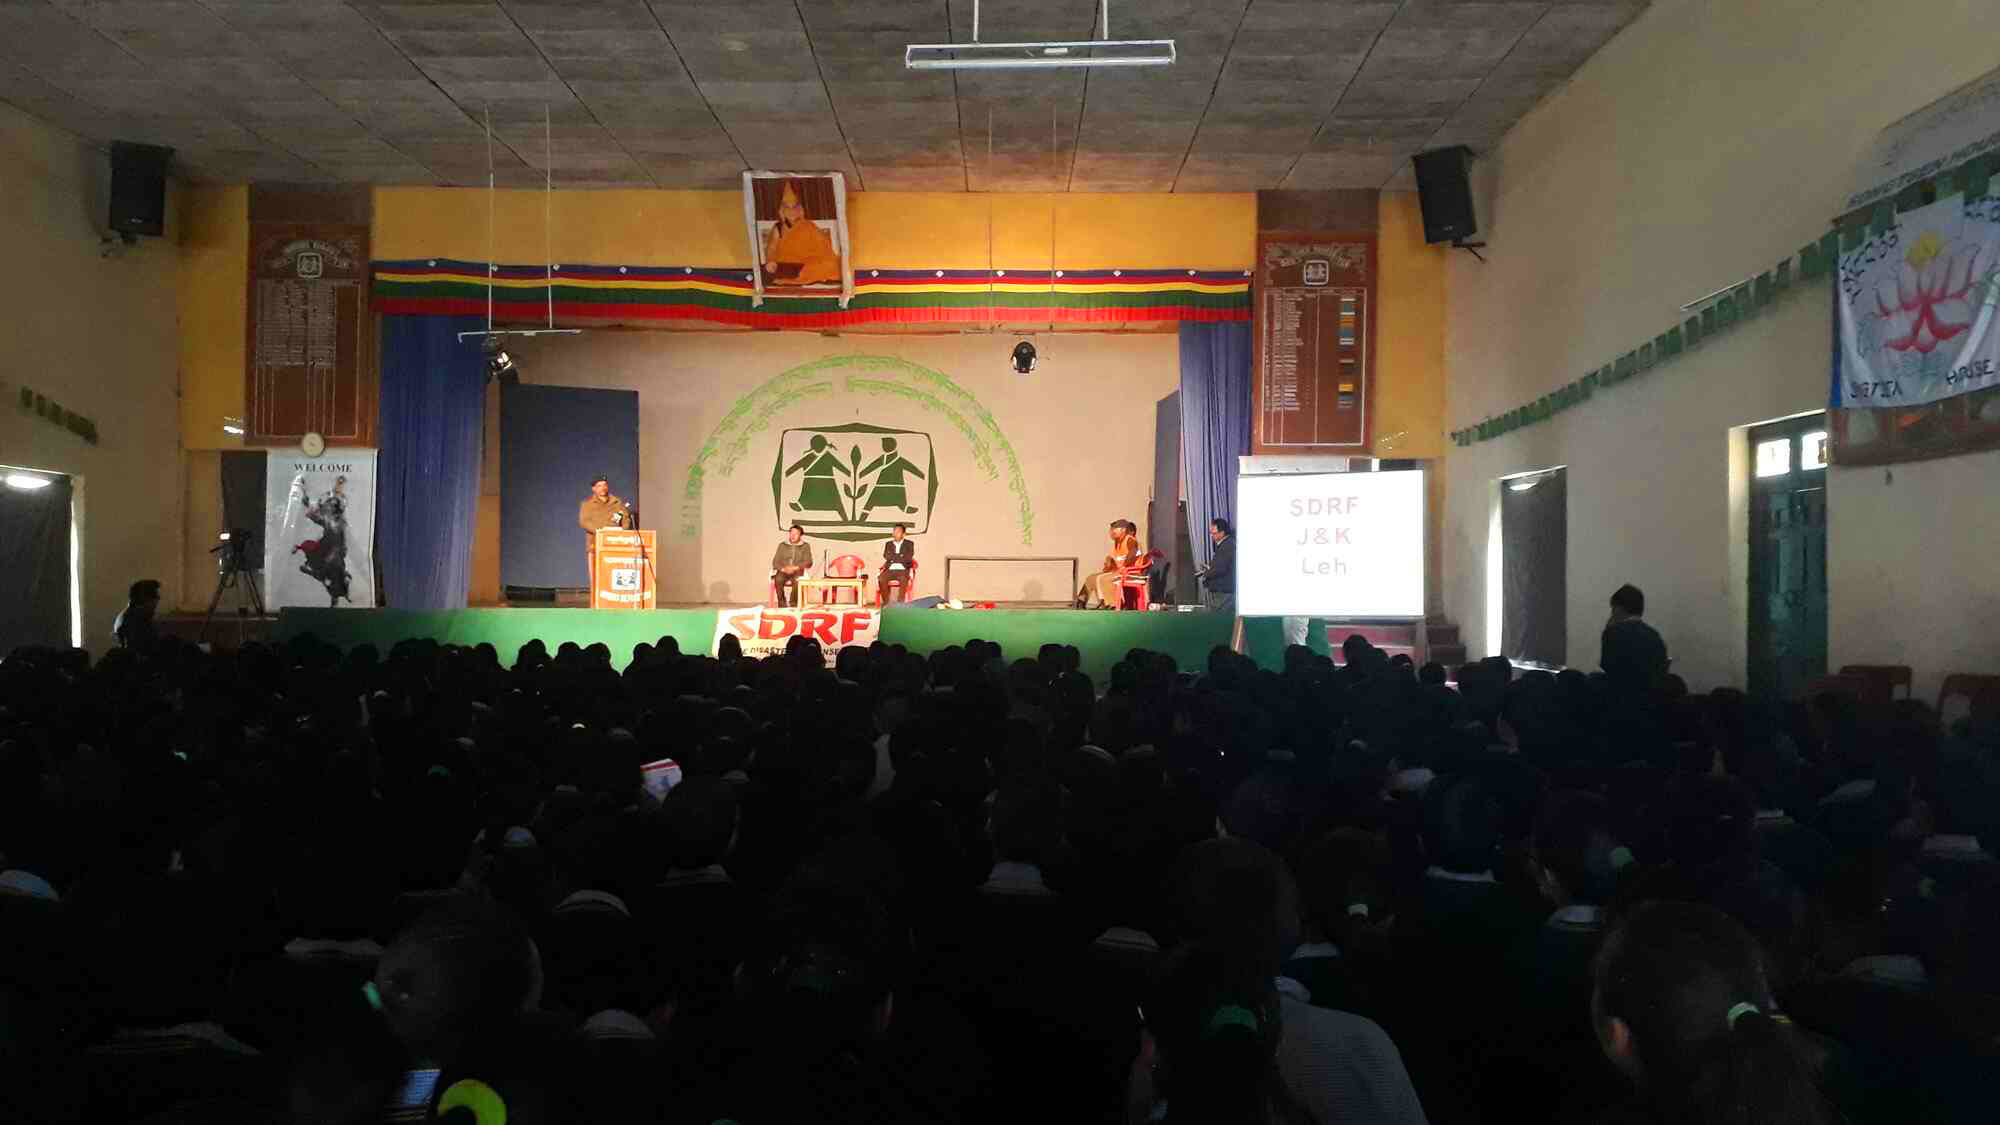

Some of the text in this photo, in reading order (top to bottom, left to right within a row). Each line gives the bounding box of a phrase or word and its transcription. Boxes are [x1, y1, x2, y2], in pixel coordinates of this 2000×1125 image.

[294, 463, 353, 473] WELCOME
[1289, 496, 1360, 517] SDRF
[1296, 527, 1352, 545] J&K
[1301, 556, 1347, 576] Leh
[728, 612, 872, 644] SDRF
